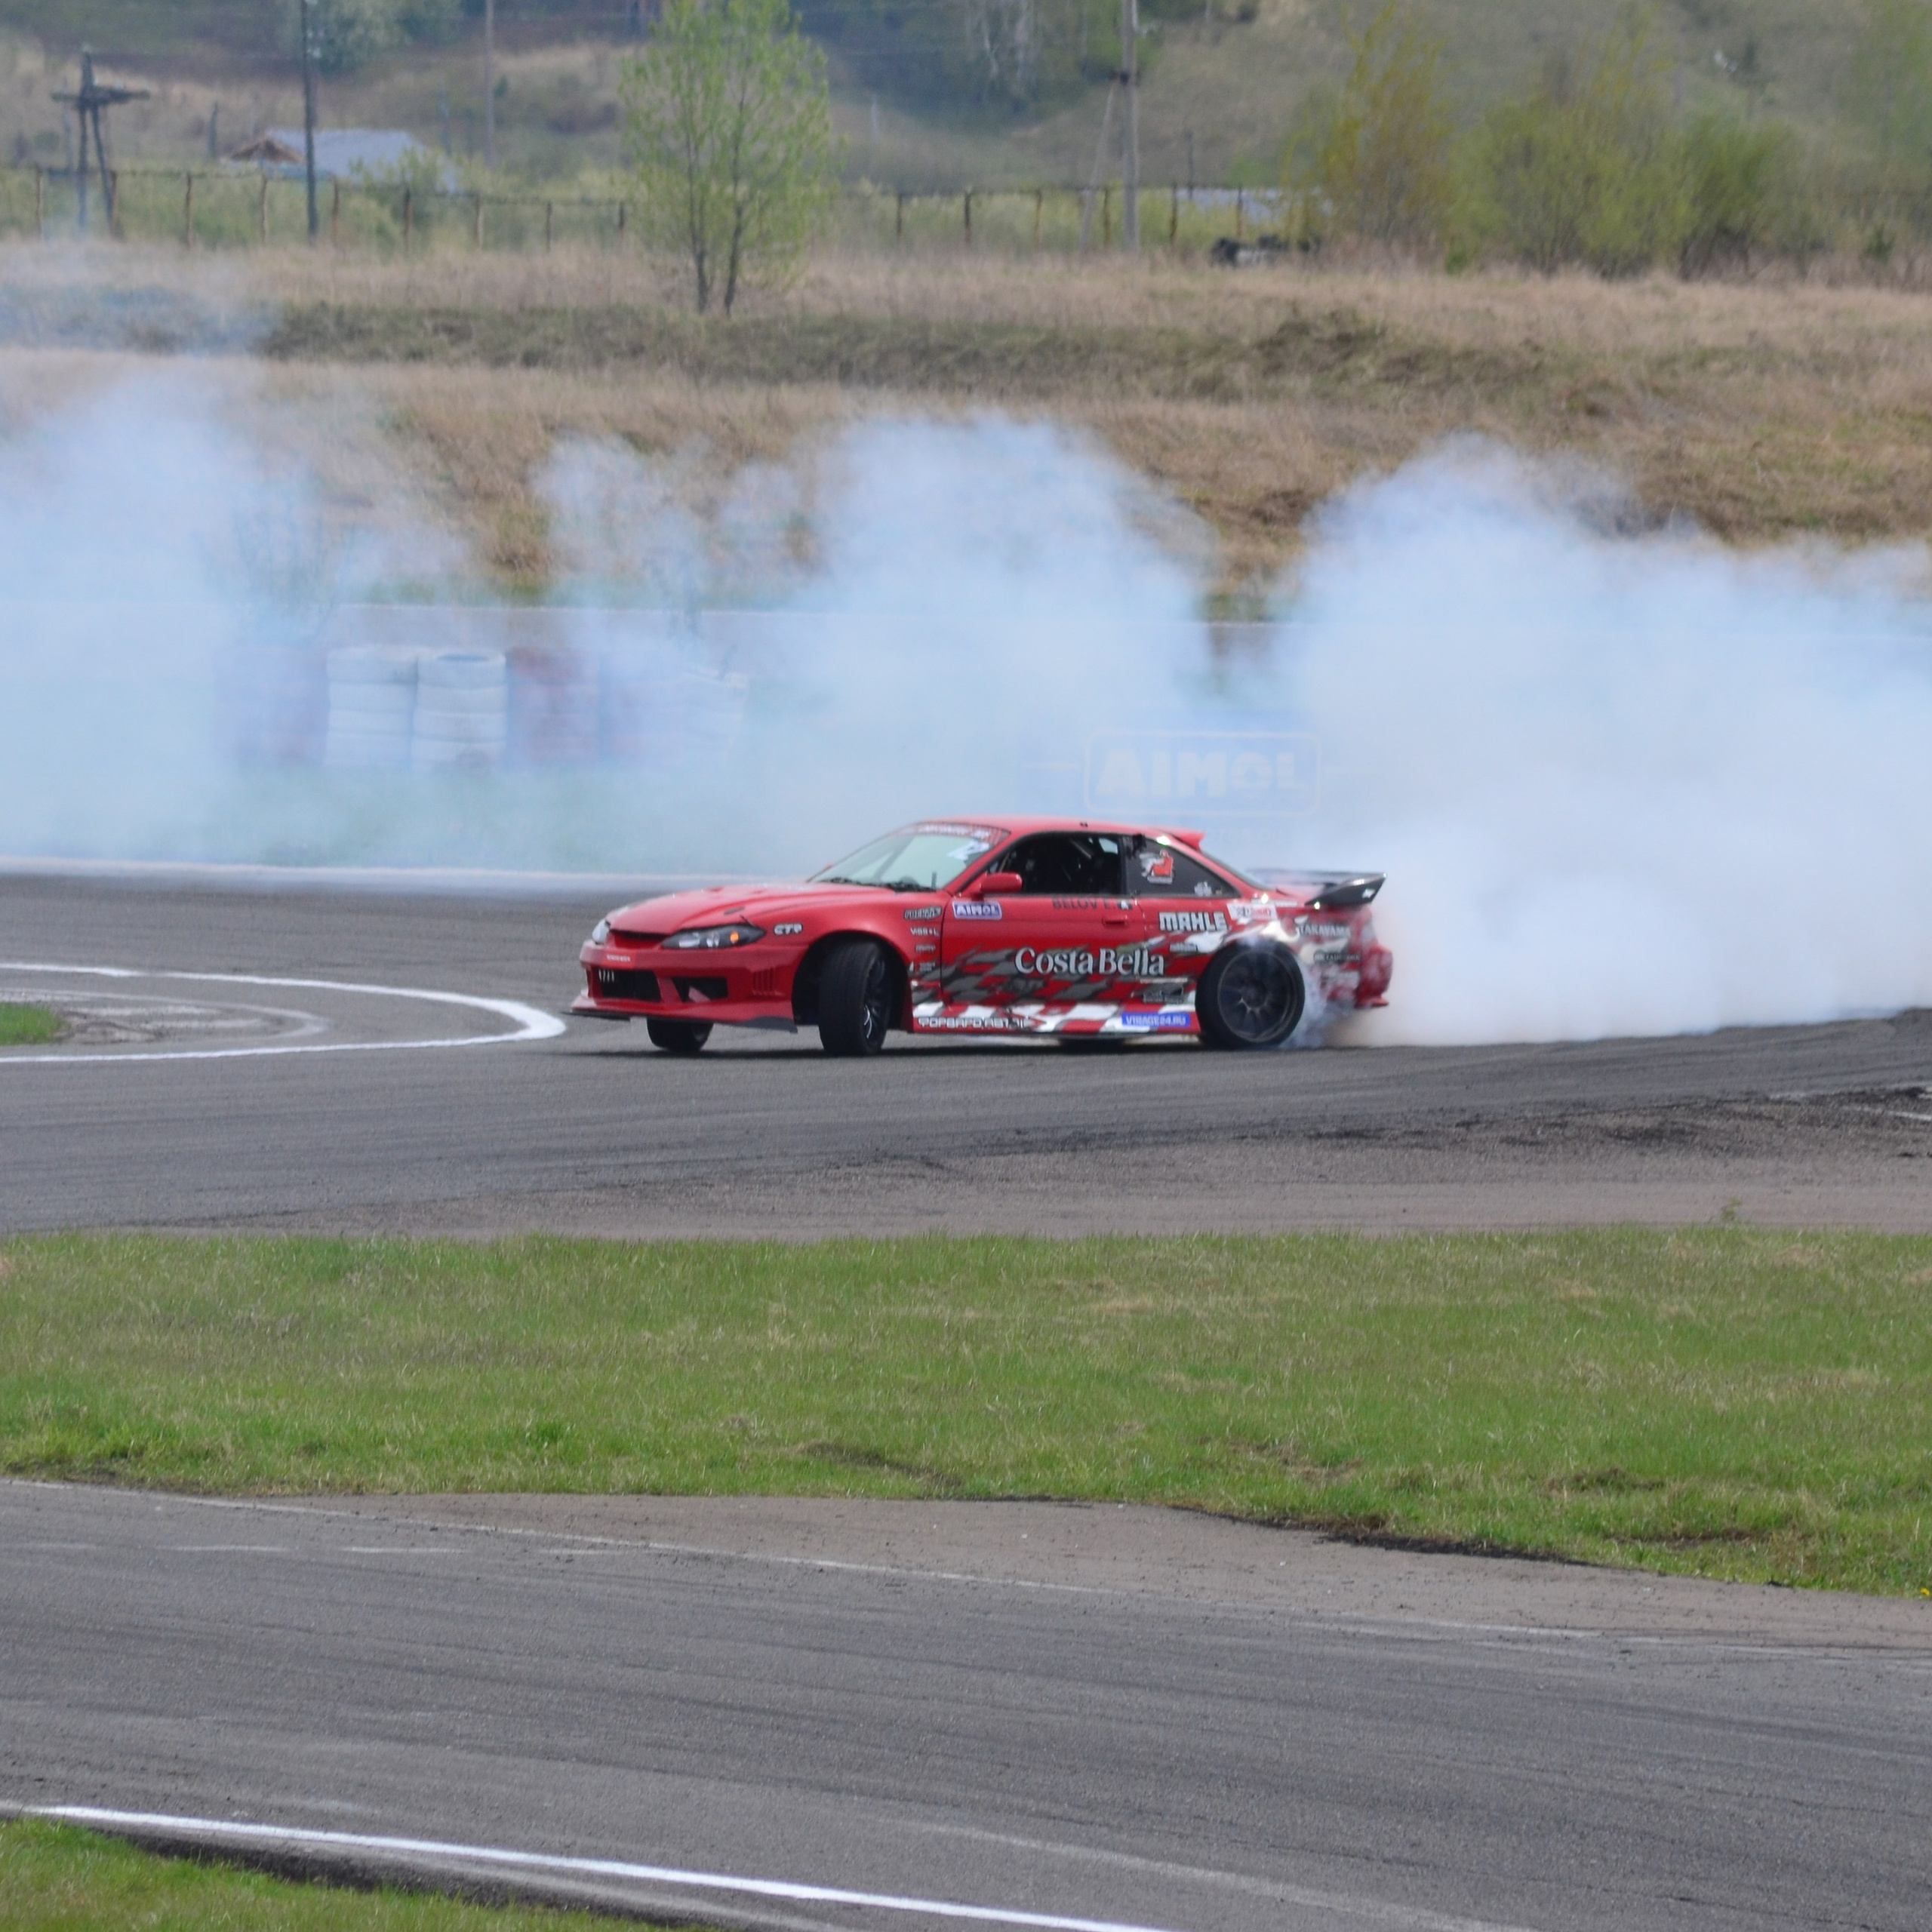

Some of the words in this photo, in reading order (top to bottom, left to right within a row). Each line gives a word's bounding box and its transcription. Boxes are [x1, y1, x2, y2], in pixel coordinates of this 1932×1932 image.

[1094, 749, 1312, 798] AIMOL
[956, 904, 999, 916] AIMOL
[1158, 911, 1228, 931] MAHLE
[1014, 946, 1094, 974] Costa
[1098, 947, 1164, 976] Bella
